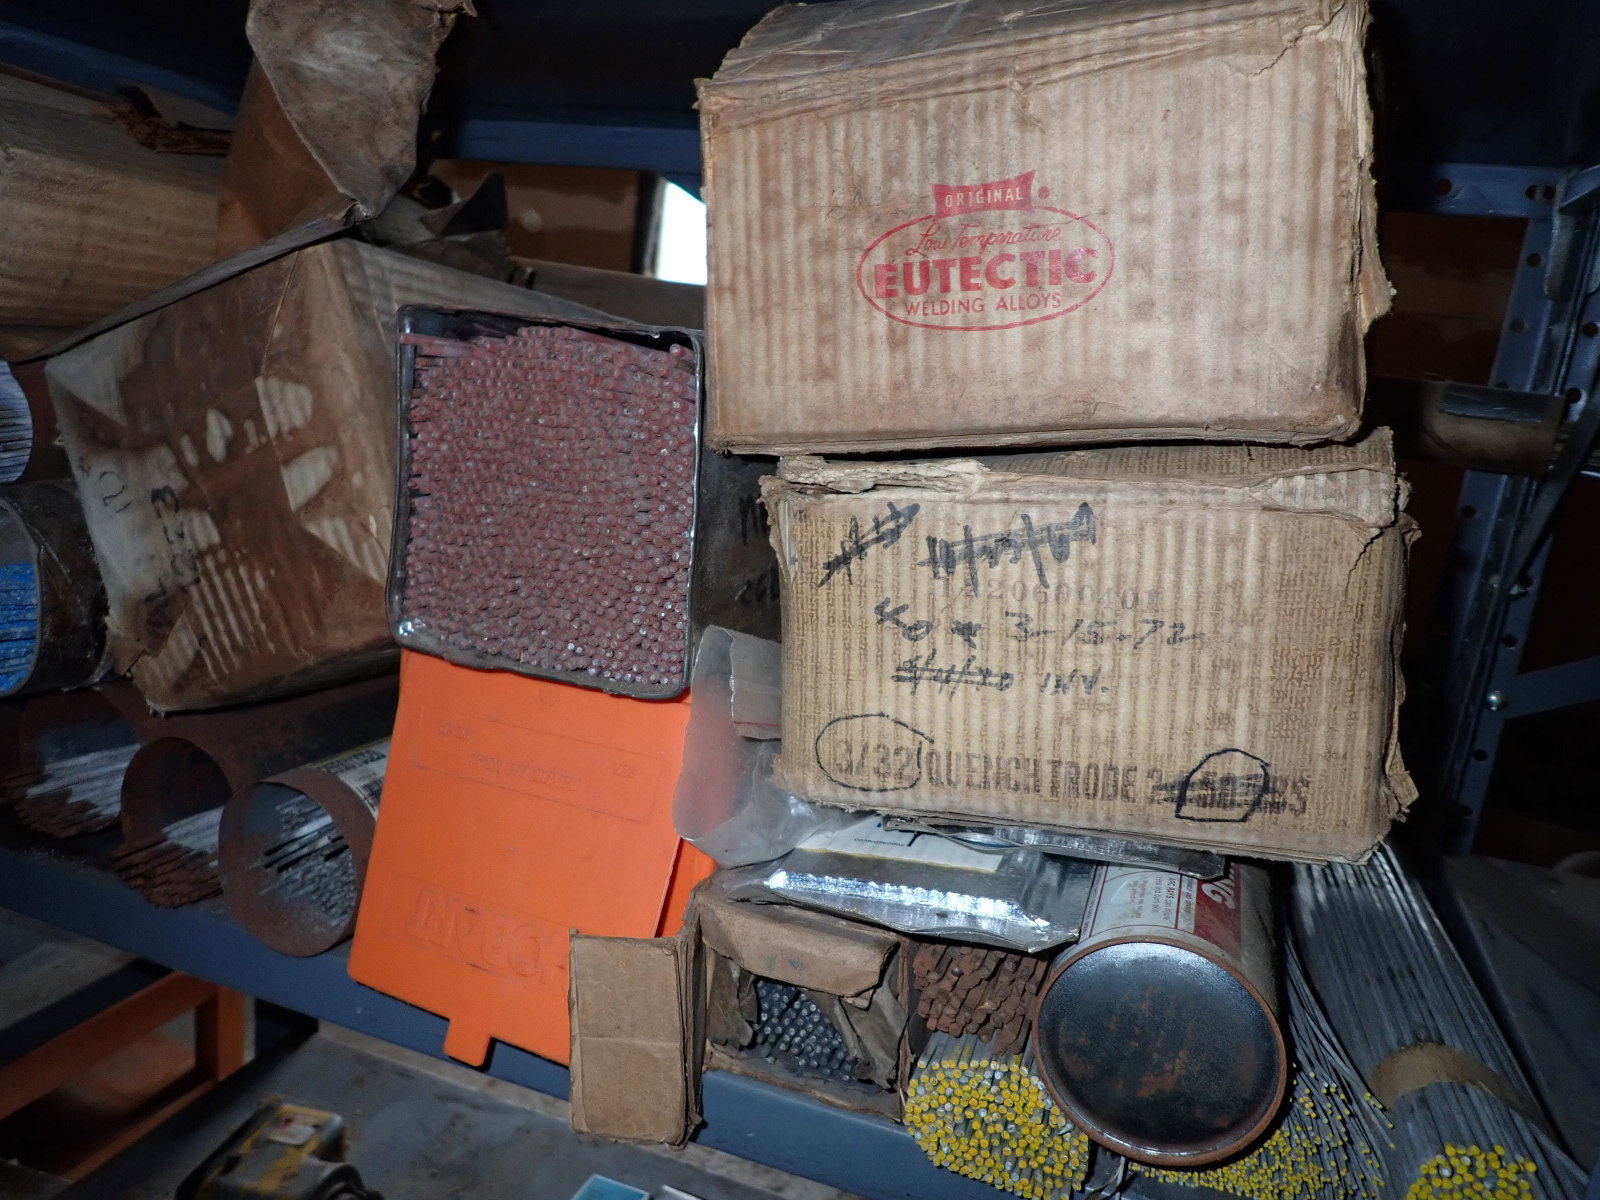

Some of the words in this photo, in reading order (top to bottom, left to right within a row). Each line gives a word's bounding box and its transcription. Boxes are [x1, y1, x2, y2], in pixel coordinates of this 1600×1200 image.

[944, 187, 1024, 208] ORIGINAL
[905, 222, 947, 257] Low
[952, 222, 1062, 254] Temperature
[874, 247, 1099, 298] EUTECTIC
[905, 297, 985, 317] WELDING
[995, 291, 1063, 312] ALLOYS
[1165, 887, 1175, 899] RAYS
[1167, 877, 1176, 886] ARC
